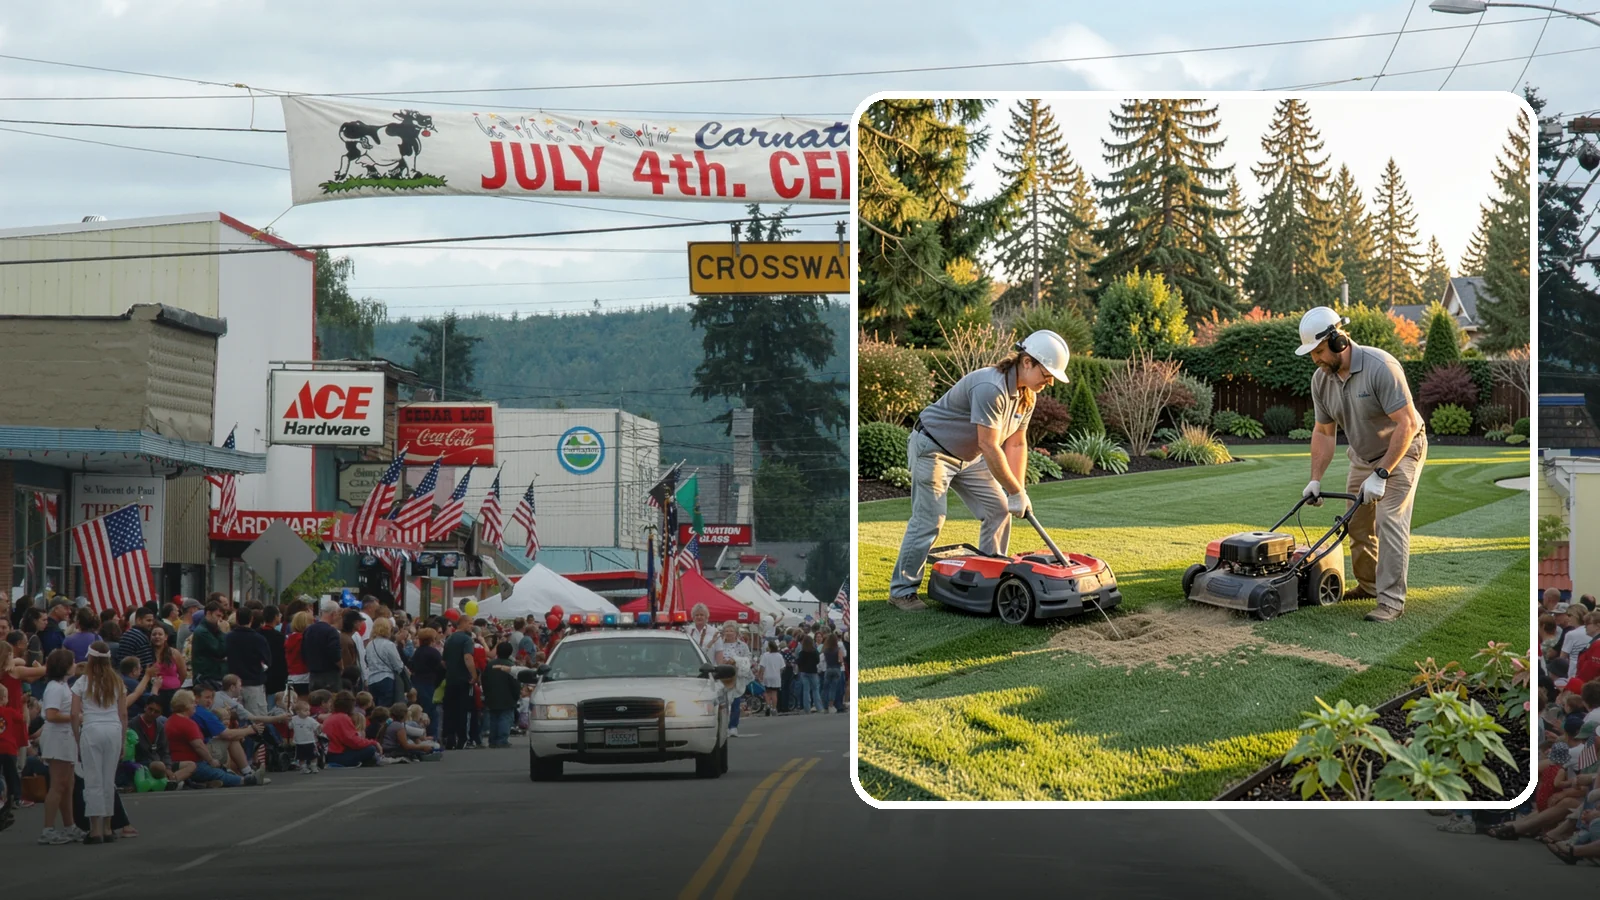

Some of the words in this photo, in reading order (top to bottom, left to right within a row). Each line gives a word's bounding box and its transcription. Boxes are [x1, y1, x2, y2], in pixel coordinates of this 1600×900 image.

[481, 141, 604, 191] JULY
[633, 150, 746, 197] 4th.
[697, 254, 850, 280] CROSSWA
[283, 380, 373, 420] ACE
[405, 409, 452, 422] CEDAR
[283, 421, 371, 437] Hardware
[416, 428, 477, 447] Coca-Cola
[96, 485, 124, 494] Vincent
[126, 486, 136, 494] de
[138, 486, 155, 495] Paul
[688, 526, 742, 534] CRNATION
[699, 535, 730, 543] GLASS
